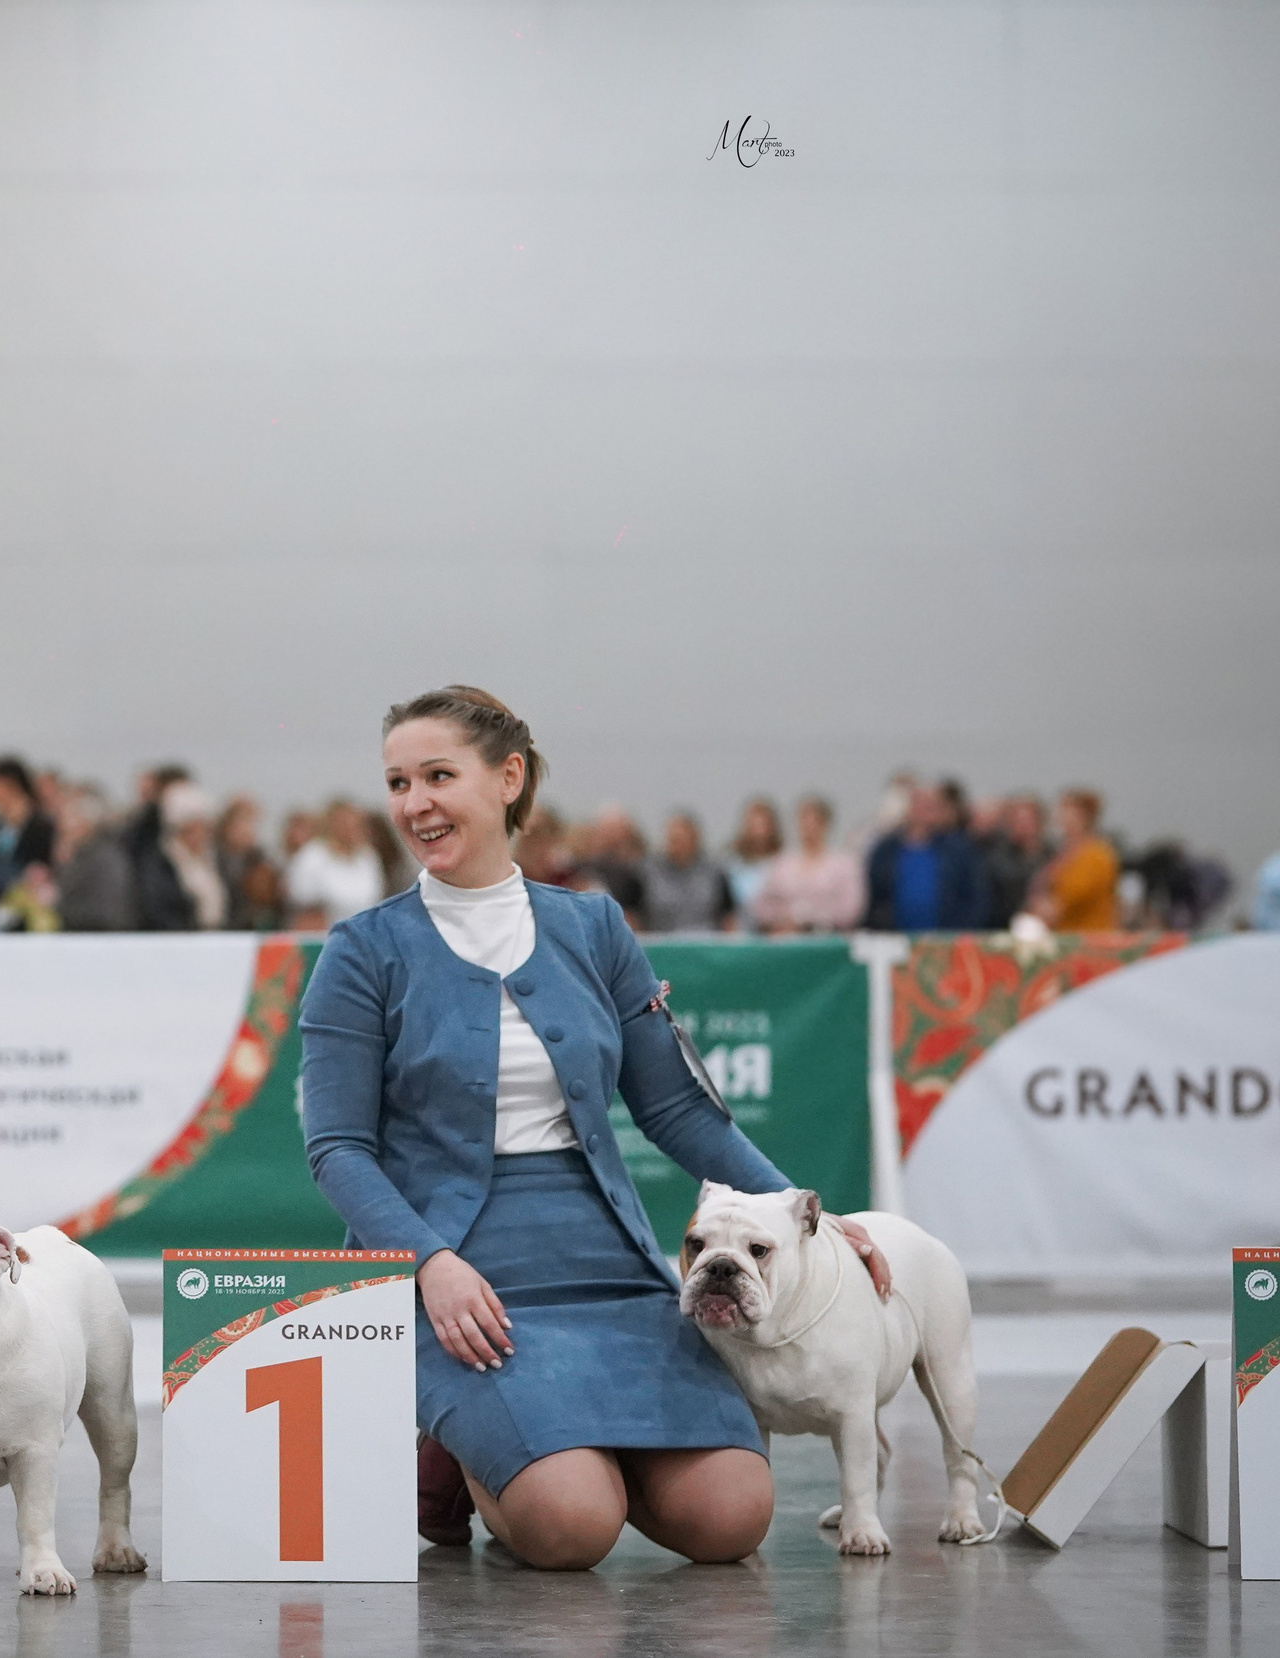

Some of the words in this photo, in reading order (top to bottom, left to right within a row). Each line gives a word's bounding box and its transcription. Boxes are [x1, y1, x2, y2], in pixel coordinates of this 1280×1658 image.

[1024, 1066, 1280, 1119] GRAND
[177, 1250, 286, 1258] НАЦИОНАЛЬНЫЕ
[371, 1251, 413, 1259] СОБАК
[214, 1275, 286, 1287] ЕВРАЗИЯ
[281, 1323, 405, 1340] GRANDORF
[246, 1356, 324, 1561] 1
